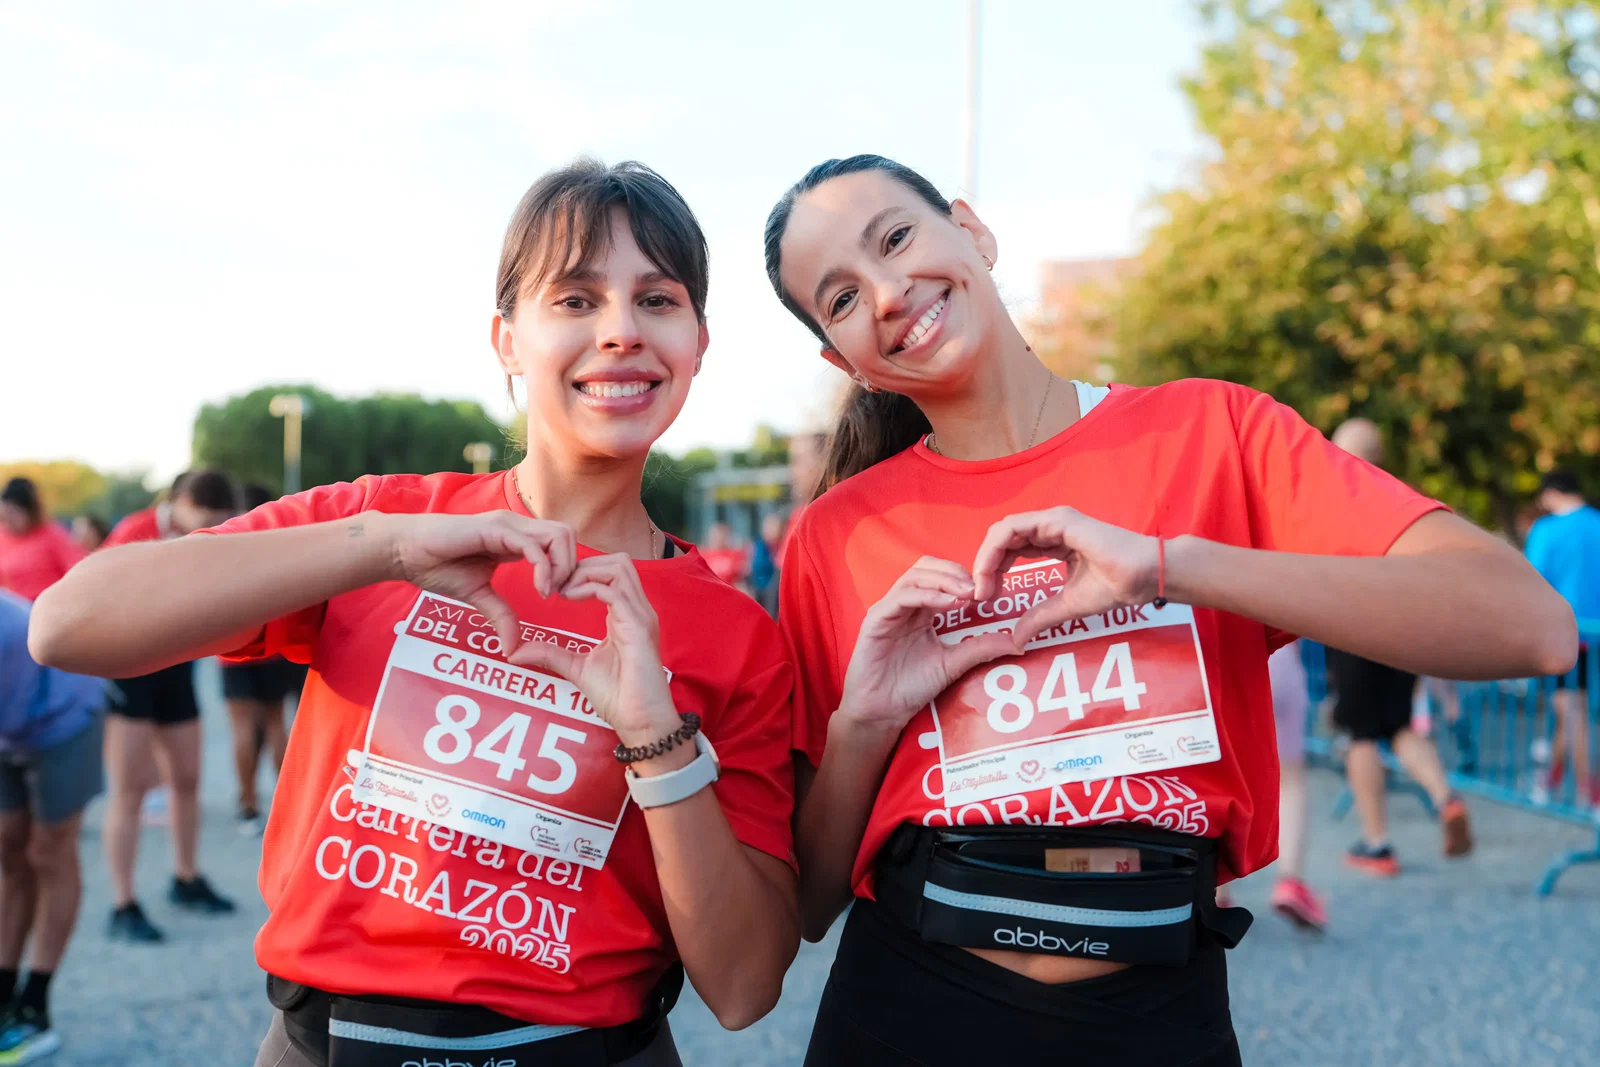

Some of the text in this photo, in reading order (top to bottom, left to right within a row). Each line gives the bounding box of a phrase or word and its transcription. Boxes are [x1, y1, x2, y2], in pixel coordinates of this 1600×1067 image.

[1002, 568, 1063, 592] RRERA
[412, 616, 459, 643] DEL
[428, 603, 464, 622] XVI
[467, 612, 558, 647] CAERA
[932, 606, 971, 631] DEL
[1098, 604, 1149, 628] 10K
[432, 653, 597, 716] CARRERA 10
[983, 642, 1147, 734] 844
[423, 694, 588, 795] 845
[1056, 755, 1103, 770] OMRON
[462, 808, 506, 830] OMRON
[535, 812, 562, 826] Organiza
[315, 834, 577, 943] CORAZÓN
[460, 924, 571, 975] 2025
[993, 926, 1110, 956] abbvie
